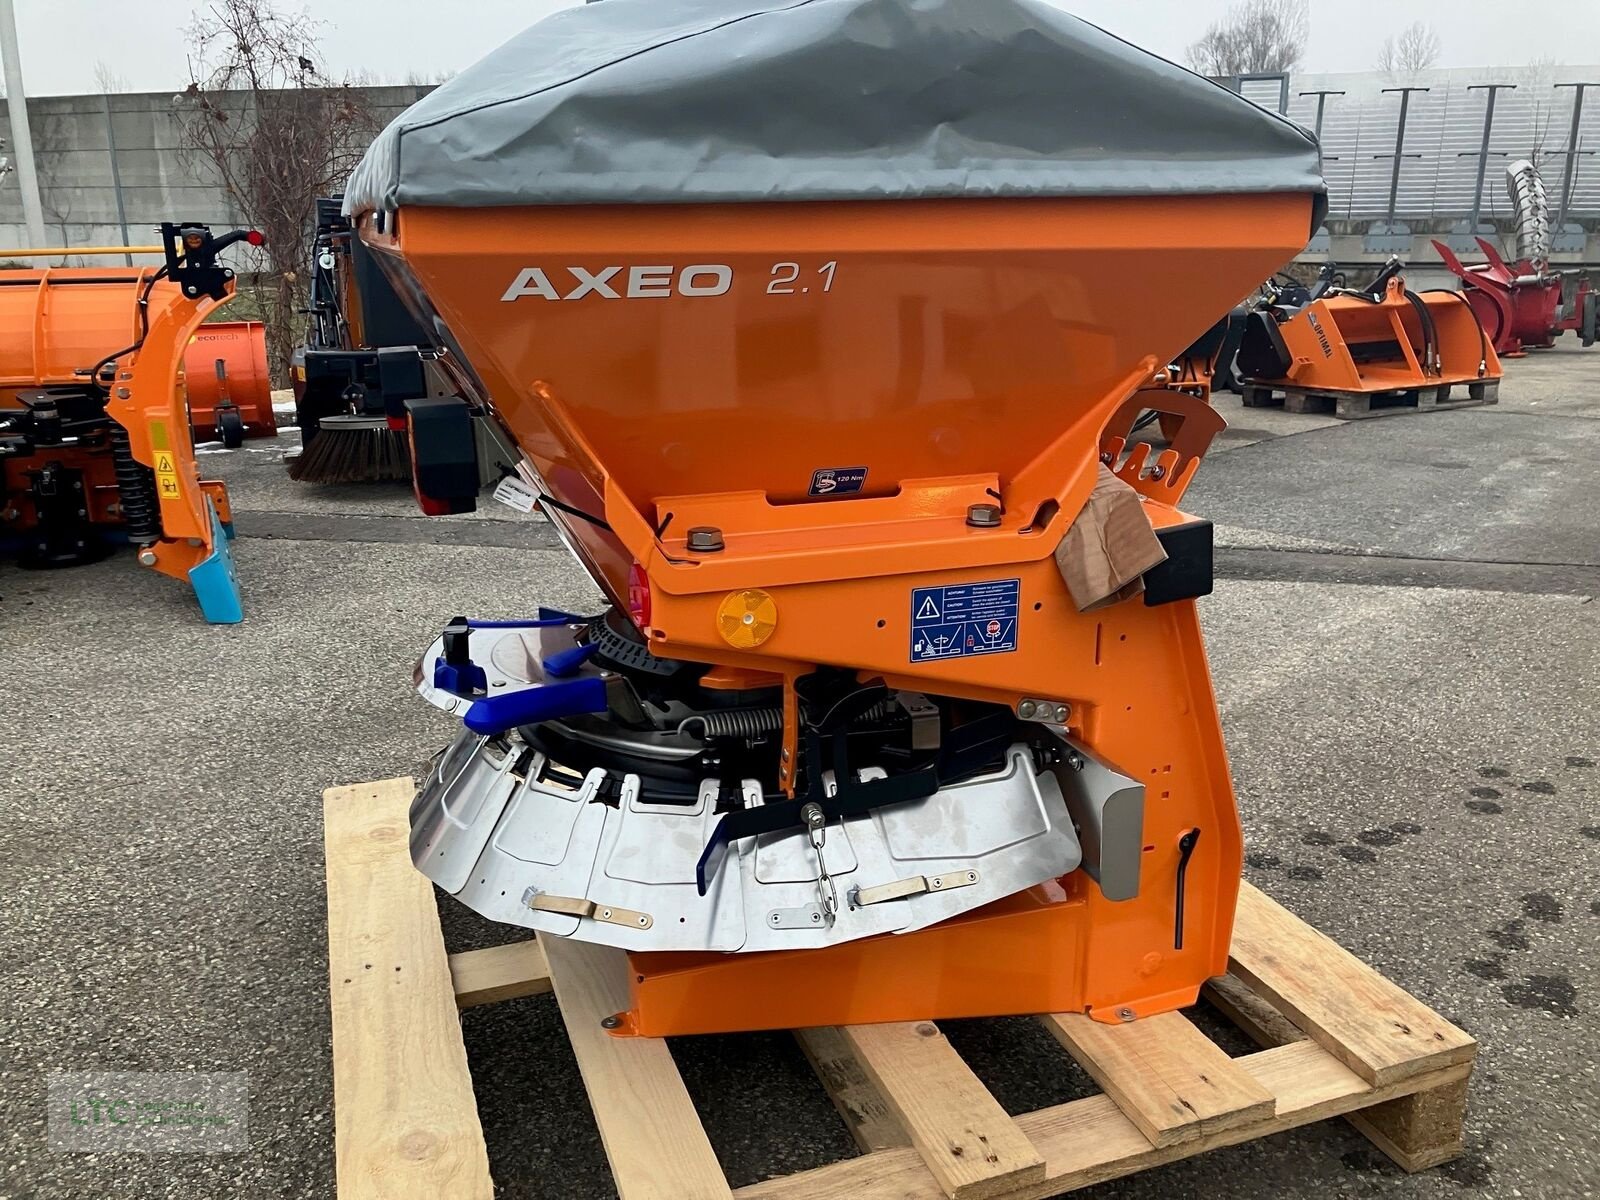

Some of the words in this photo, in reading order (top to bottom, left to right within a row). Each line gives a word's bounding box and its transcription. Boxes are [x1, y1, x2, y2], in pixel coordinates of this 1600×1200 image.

[500, 264, 733, 301] AXEO
[766, 261, 837, 295] 2.1
[1314, 324, 1333, 359] OPTIMAL
